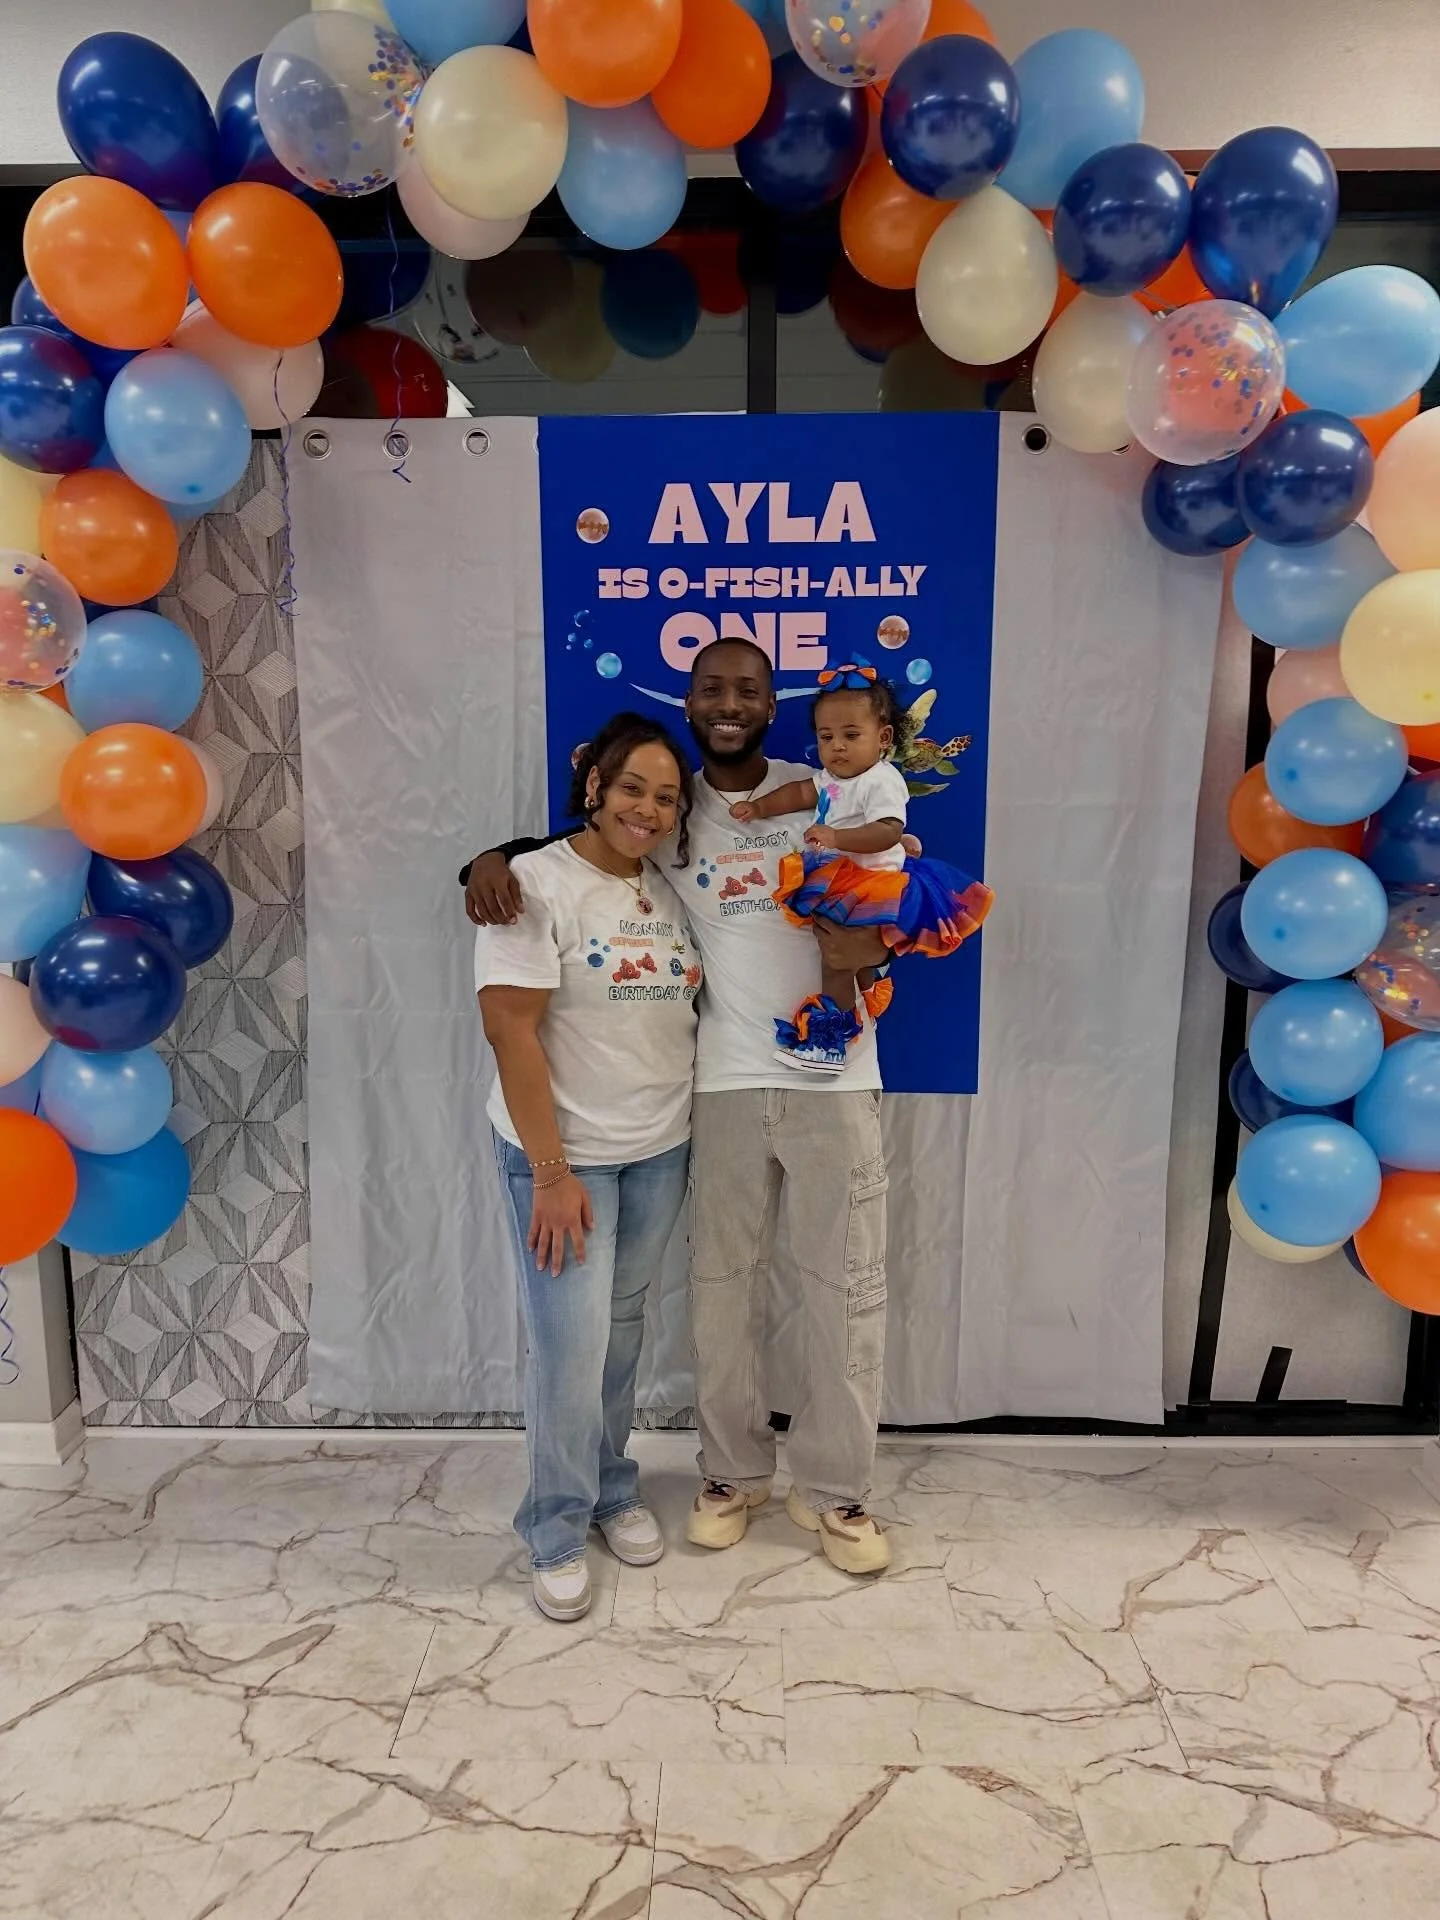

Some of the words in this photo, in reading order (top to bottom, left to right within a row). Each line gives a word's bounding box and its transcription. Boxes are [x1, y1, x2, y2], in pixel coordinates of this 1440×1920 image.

[648, 481, 877, 544] AYLA
[598, 568, 649, 599] IS
[658, 565, 928, 599] O-FISH-ALLY
[734, 831, 789, 851] DADDY
[609, 986, 681, 1001] BIRTHDAY
